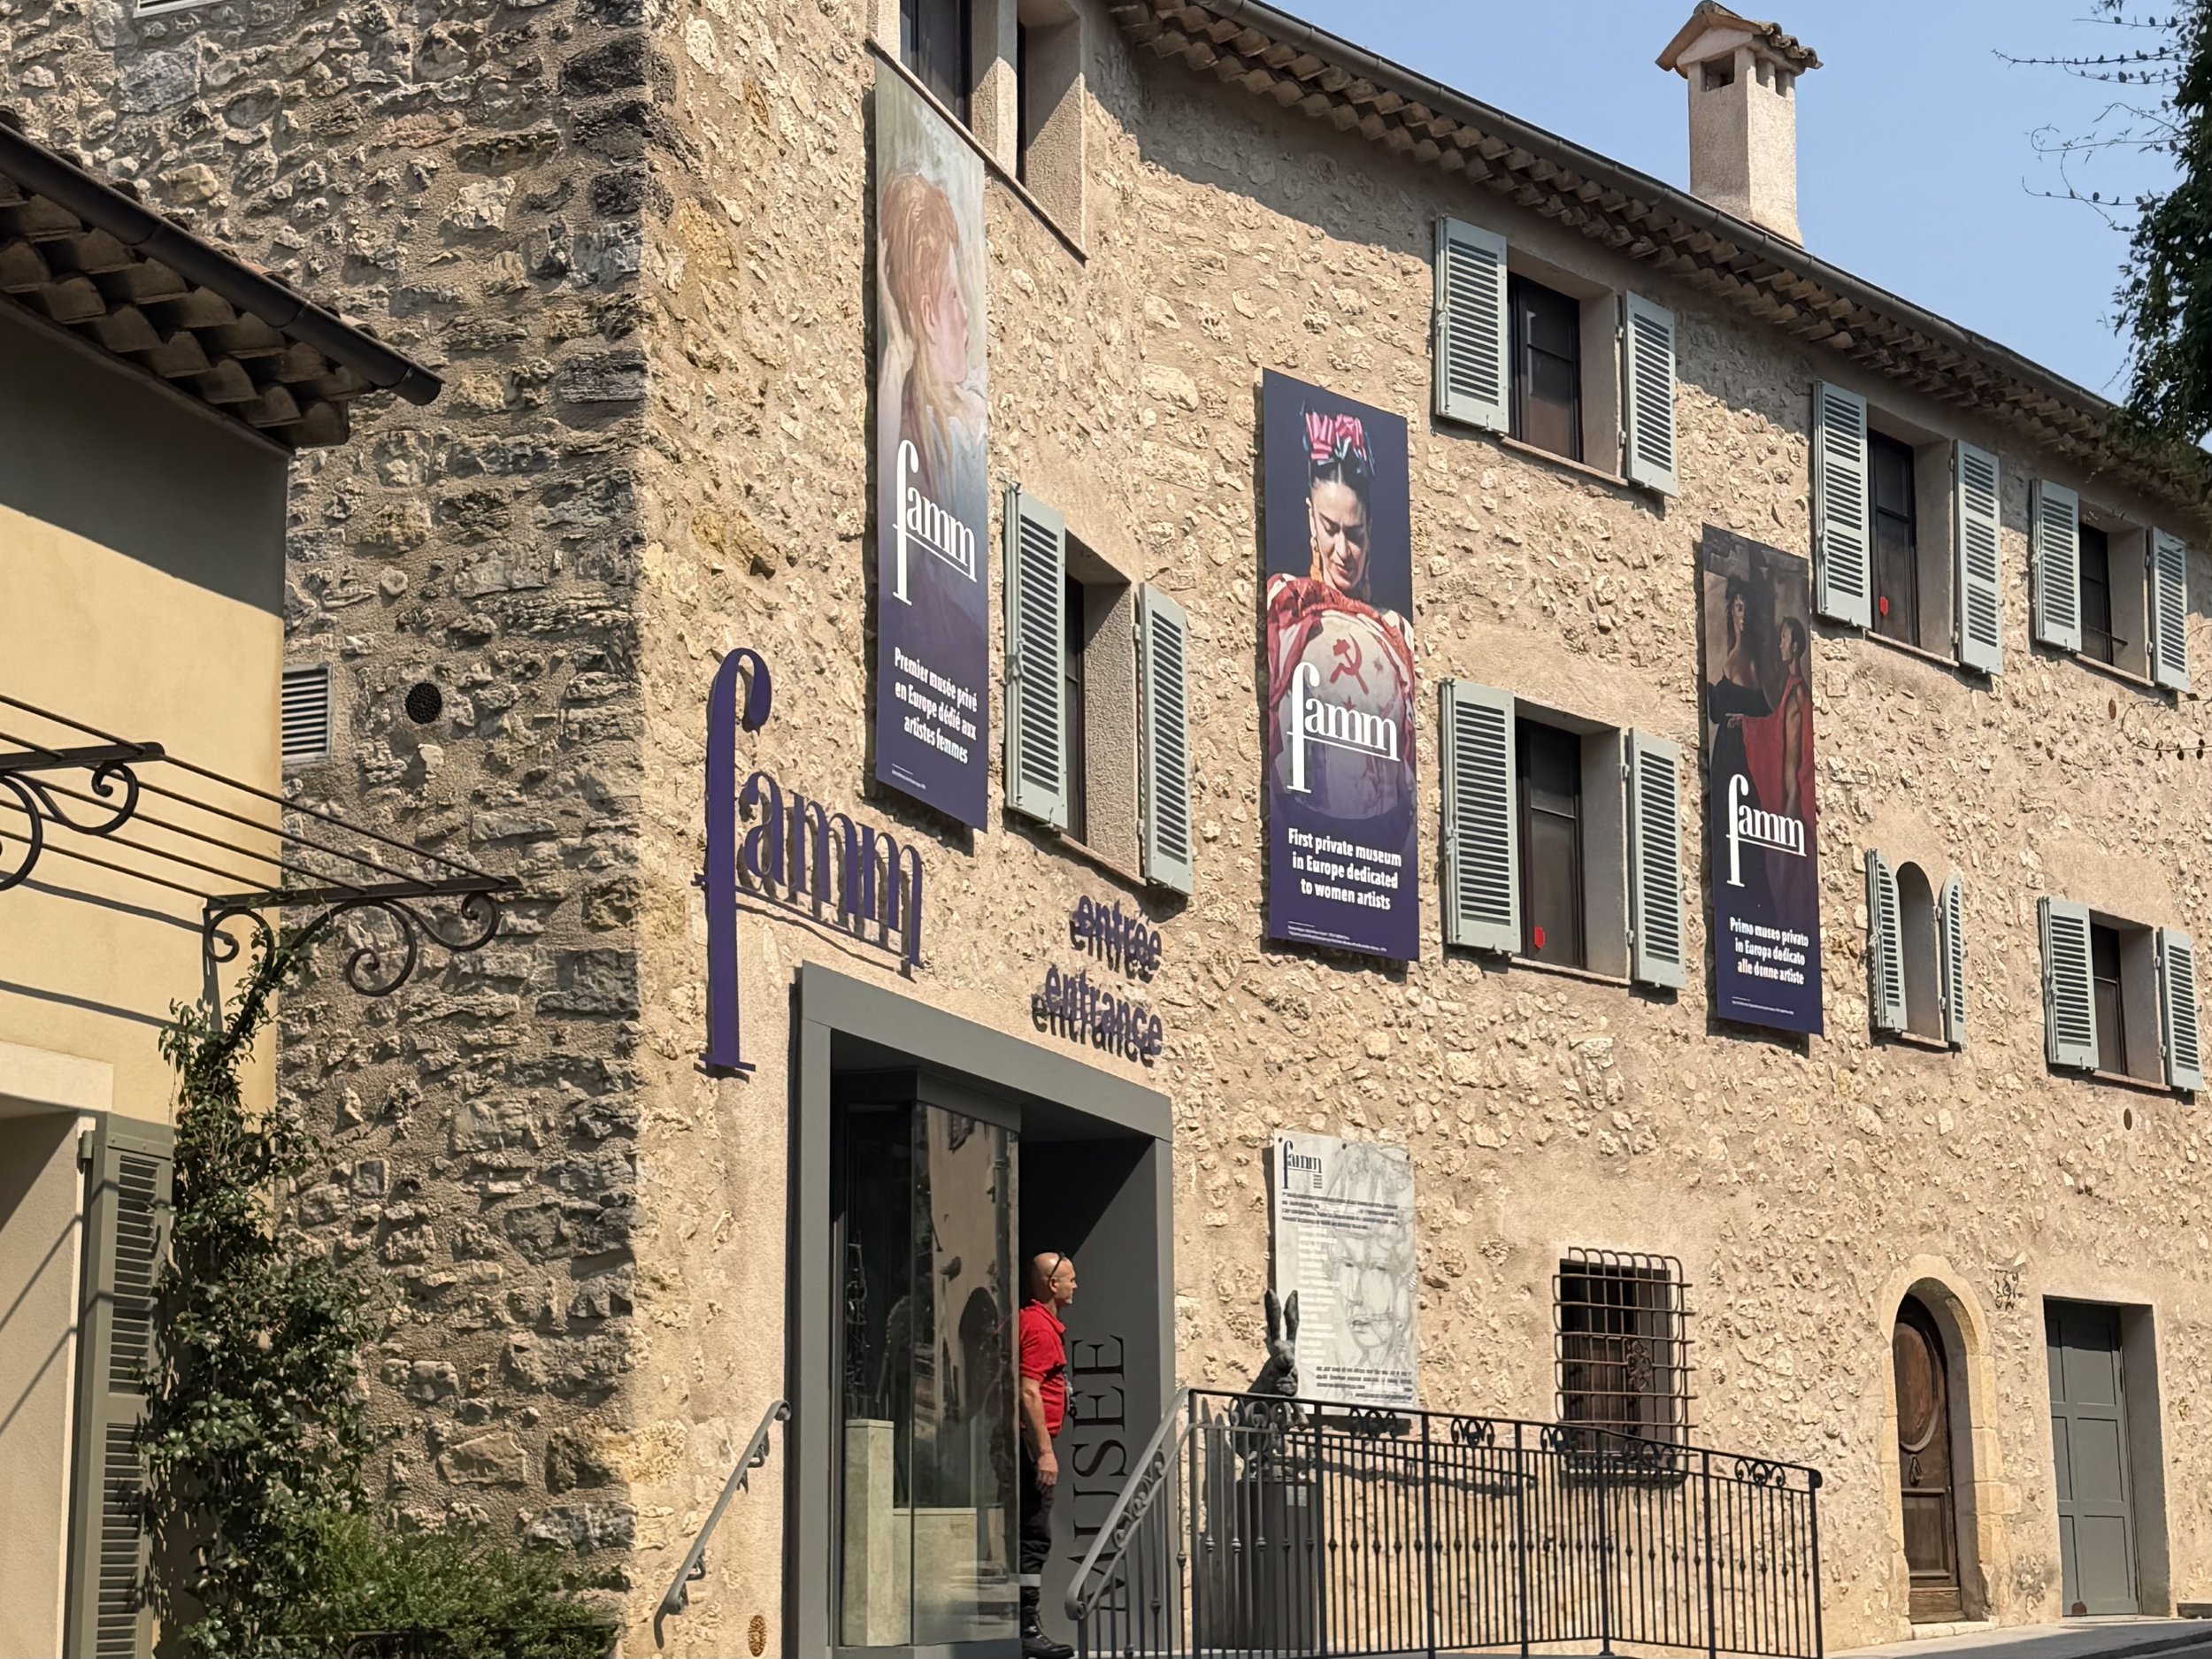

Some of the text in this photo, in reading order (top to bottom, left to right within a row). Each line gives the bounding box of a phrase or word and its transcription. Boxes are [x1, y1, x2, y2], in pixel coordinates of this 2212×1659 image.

[892, 439, 977, 605] famm
[894, 646, 928, 683] Premier
[956, 687, 978, 712] privé
[895, 681, 907, 702] en
[908, 683, 938, 719] Europe
[903, 716, 968, 764] artistes femmes
[1286, 662, 1401, 793] famm
[1287, 827, 1402, 867] First private museum
[1726, 773, 1807, 887] famm
[694, 648, 923, 1071] famm
[1292, 850, 1399, 889] in Europe dedicated
[1300, 878, 1391, 910] to women artists
[1730, 916, 1809, 948] Primo museo privato
[1734, 936, 1806, 966] in Europa dedicato
[1737, 957, 1805, 985] alle donne artiste
[1045, 964, 1163, 1056] entrance
[1281, 1140, 1322, 1189] famm
